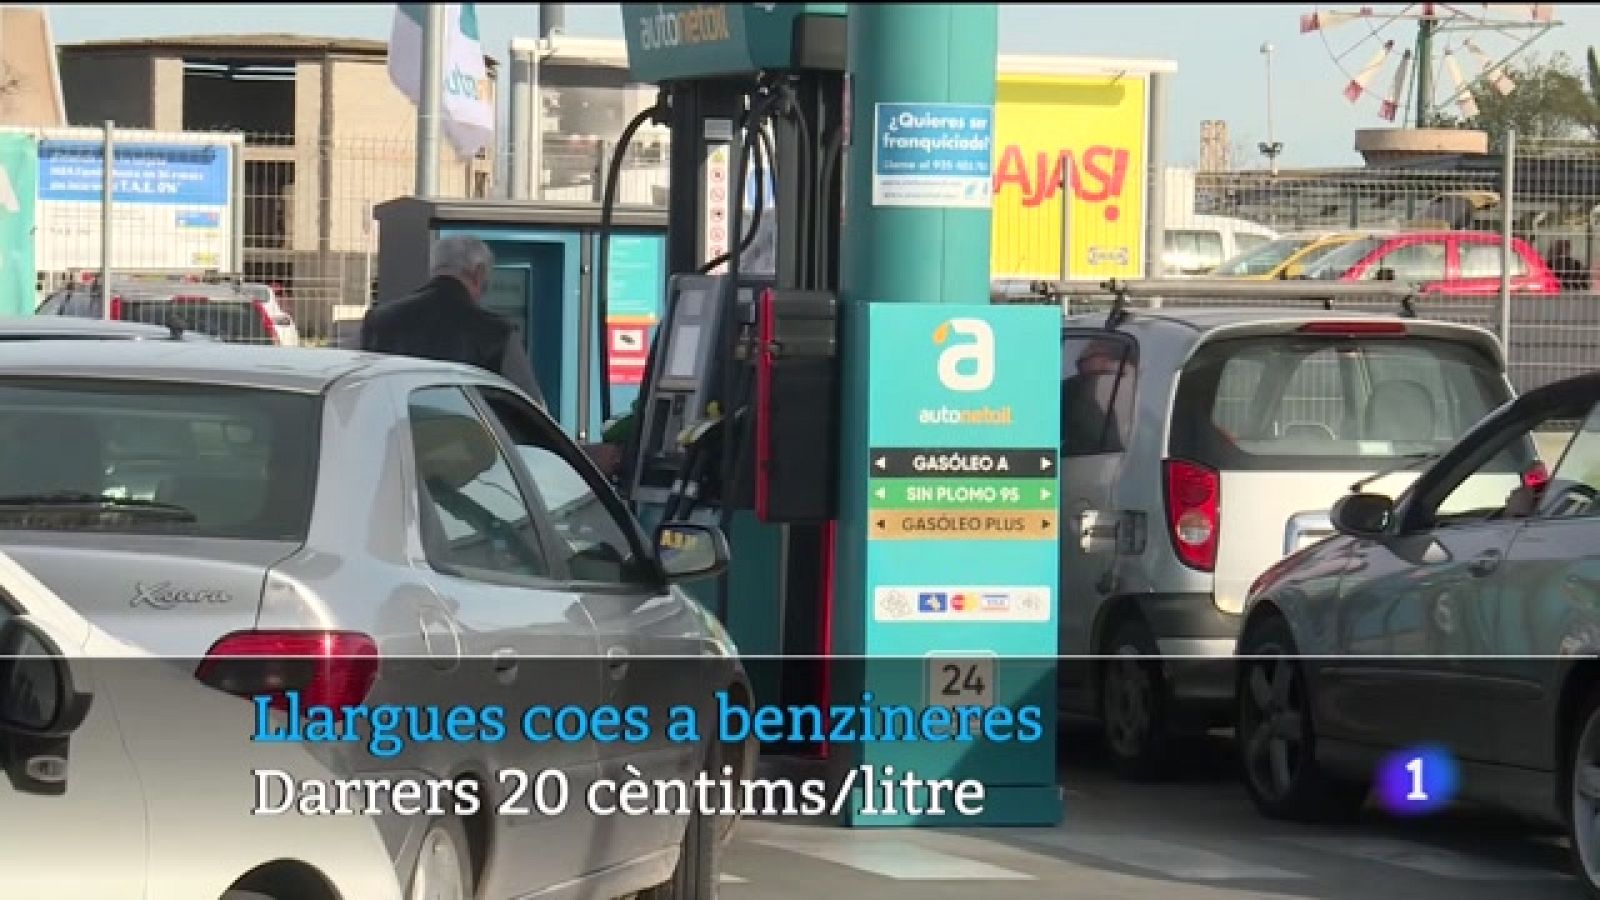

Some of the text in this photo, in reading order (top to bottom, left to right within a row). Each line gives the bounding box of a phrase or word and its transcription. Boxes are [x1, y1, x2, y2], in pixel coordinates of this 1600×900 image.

[889, 112, 965, 131] ¿Quieres
[919, 405, 1012, 425] autonetoil
[913, 453, 1008, 471] GASÓLEO A
[906, 487, 1021, 503] SIN PLOMO 95
[902, 514, 1025, 531] GASÓLEO PLUS
[941, 664, 985, 696] 24
